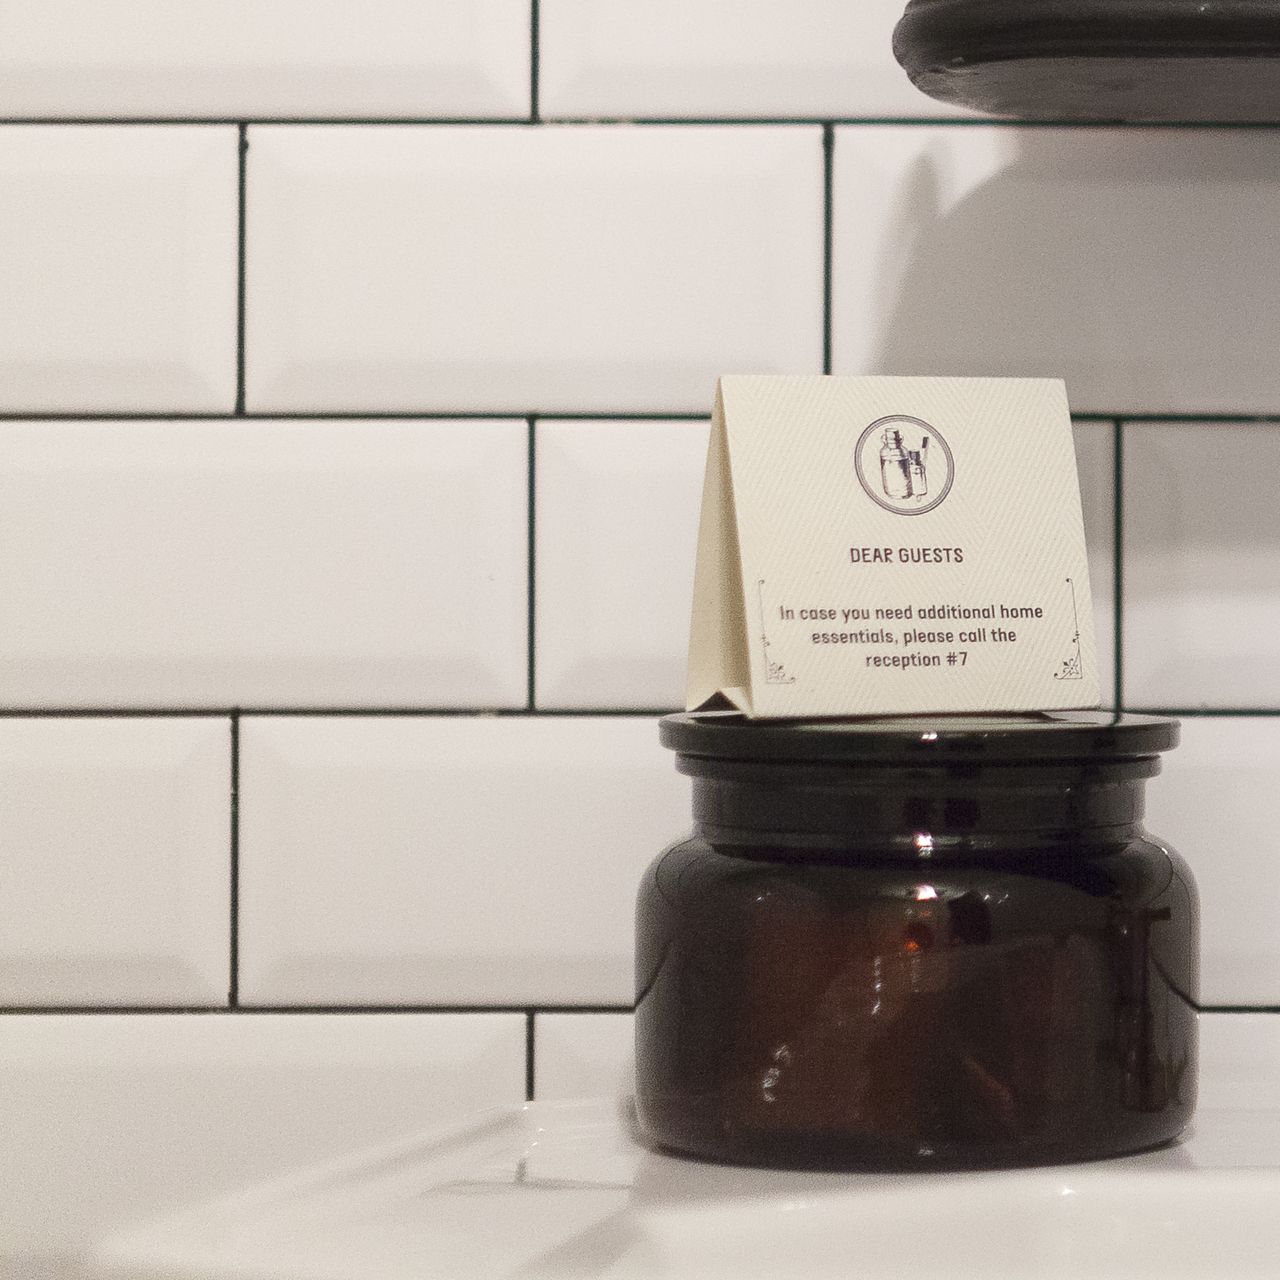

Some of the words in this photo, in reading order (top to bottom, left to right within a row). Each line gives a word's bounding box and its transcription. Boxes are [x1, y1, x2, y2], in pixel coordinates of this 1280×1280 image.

[849, 547, 894, 564] DEAR
[898, 547, 964, 564] GUESTS
[779, 605, 795, 621] In
[799, 608, 837, 621] case
[842, 608, 871, 625] you
[874, 604, 913, 620] need
[917, 603, 996, 620] additional
[999, 603, 1044, 619] home
[811, 627, 899, 646] essentials,
[903, 627, 955, 647] please
[958, 627, 987, 643] call
[990, 627, 1017, 643] the
[865, 651, 942, 671] reception
[945, 651, 969, 667] #7
